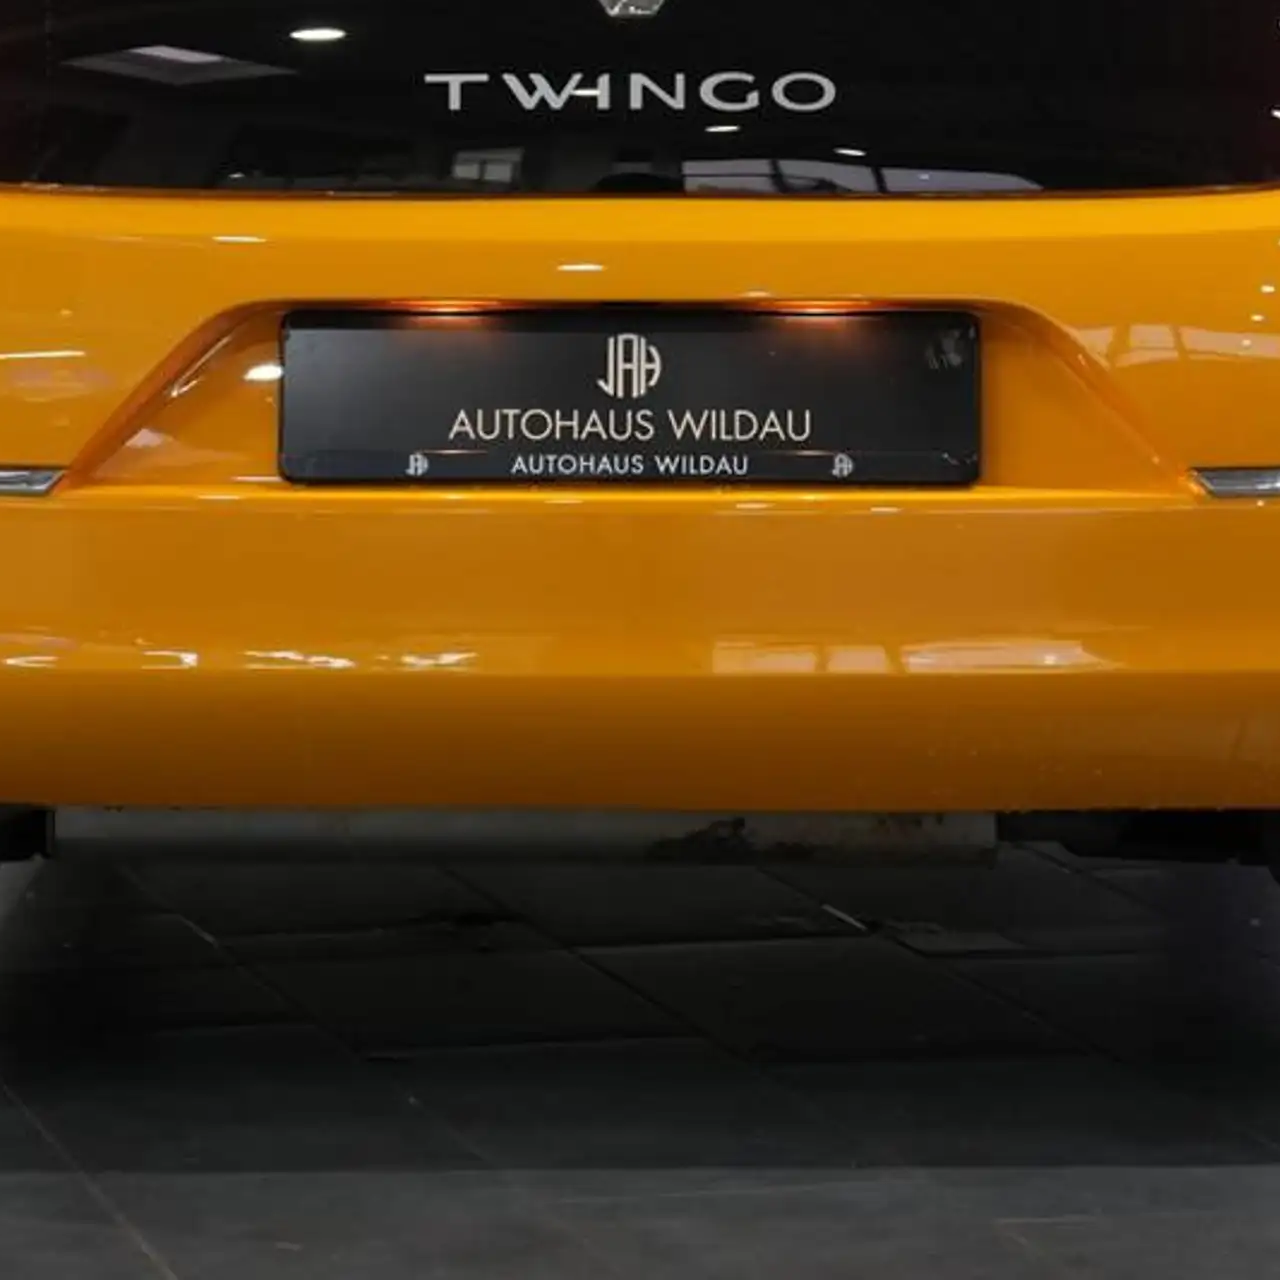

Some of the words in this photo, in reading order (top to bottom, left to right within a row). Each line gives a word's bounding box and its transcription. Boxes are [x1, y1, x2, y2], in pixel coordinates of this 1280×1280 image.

[424, 71, 836, 111] TWINGO
[448, 408, 655, 442] AUTOHAUS
[666, 409, 811, 442] WILDAU
[510, 453, 644, 475] AUTOHAUS
[654, 454, 748, 476] WILDAU
